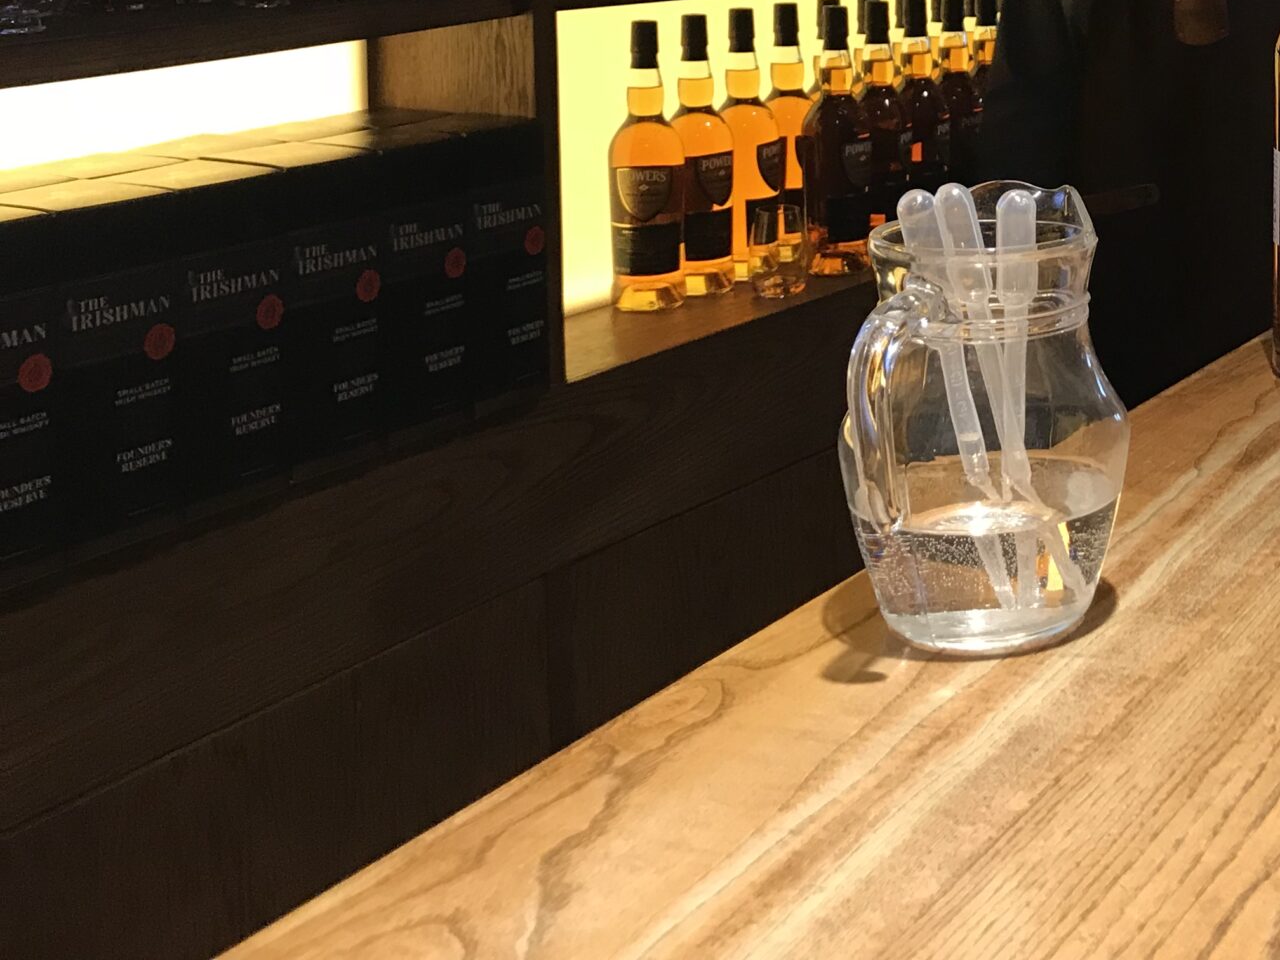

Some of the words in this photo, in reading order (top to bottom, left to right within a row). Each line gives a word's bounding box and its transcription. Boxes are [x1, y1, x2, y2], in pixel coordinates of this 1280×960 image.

[622, 169, 667, 183] OWERS
[298, 244, 378, 276] IRISHMAN
[304, 243, 329, 259] THE
[200, 267, 225, 285] THE
[191, 268, 281, 304] IRISHMAN
[71, 294, 171, 332] IRISHMAN
[79, 295, 110, 313] THE
